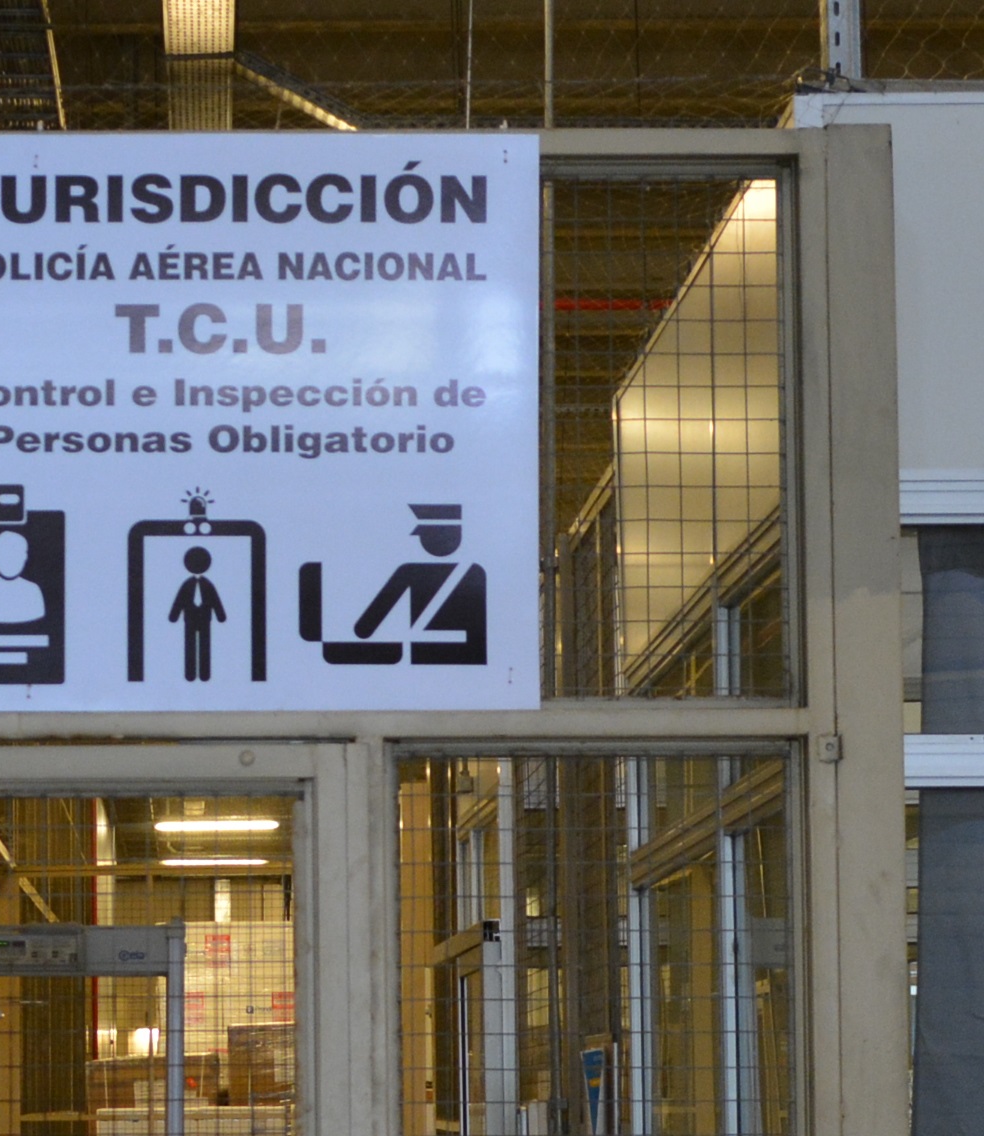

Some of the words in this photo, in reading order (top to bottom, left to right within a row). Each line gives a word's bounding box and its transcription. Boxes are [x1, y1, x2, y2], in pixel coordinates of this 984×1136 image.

[129, 245, 264, 282] AÉREA
[278, 252, 488, 282] NACIONAL
[115, 302, 328, 356] T.C.U.
[132, 386, 158, 408] e
[175, 378, 419, 415] Inspección
[434, 378, 487, 408] de
[209, 425, 456, 461] Obligatorio
